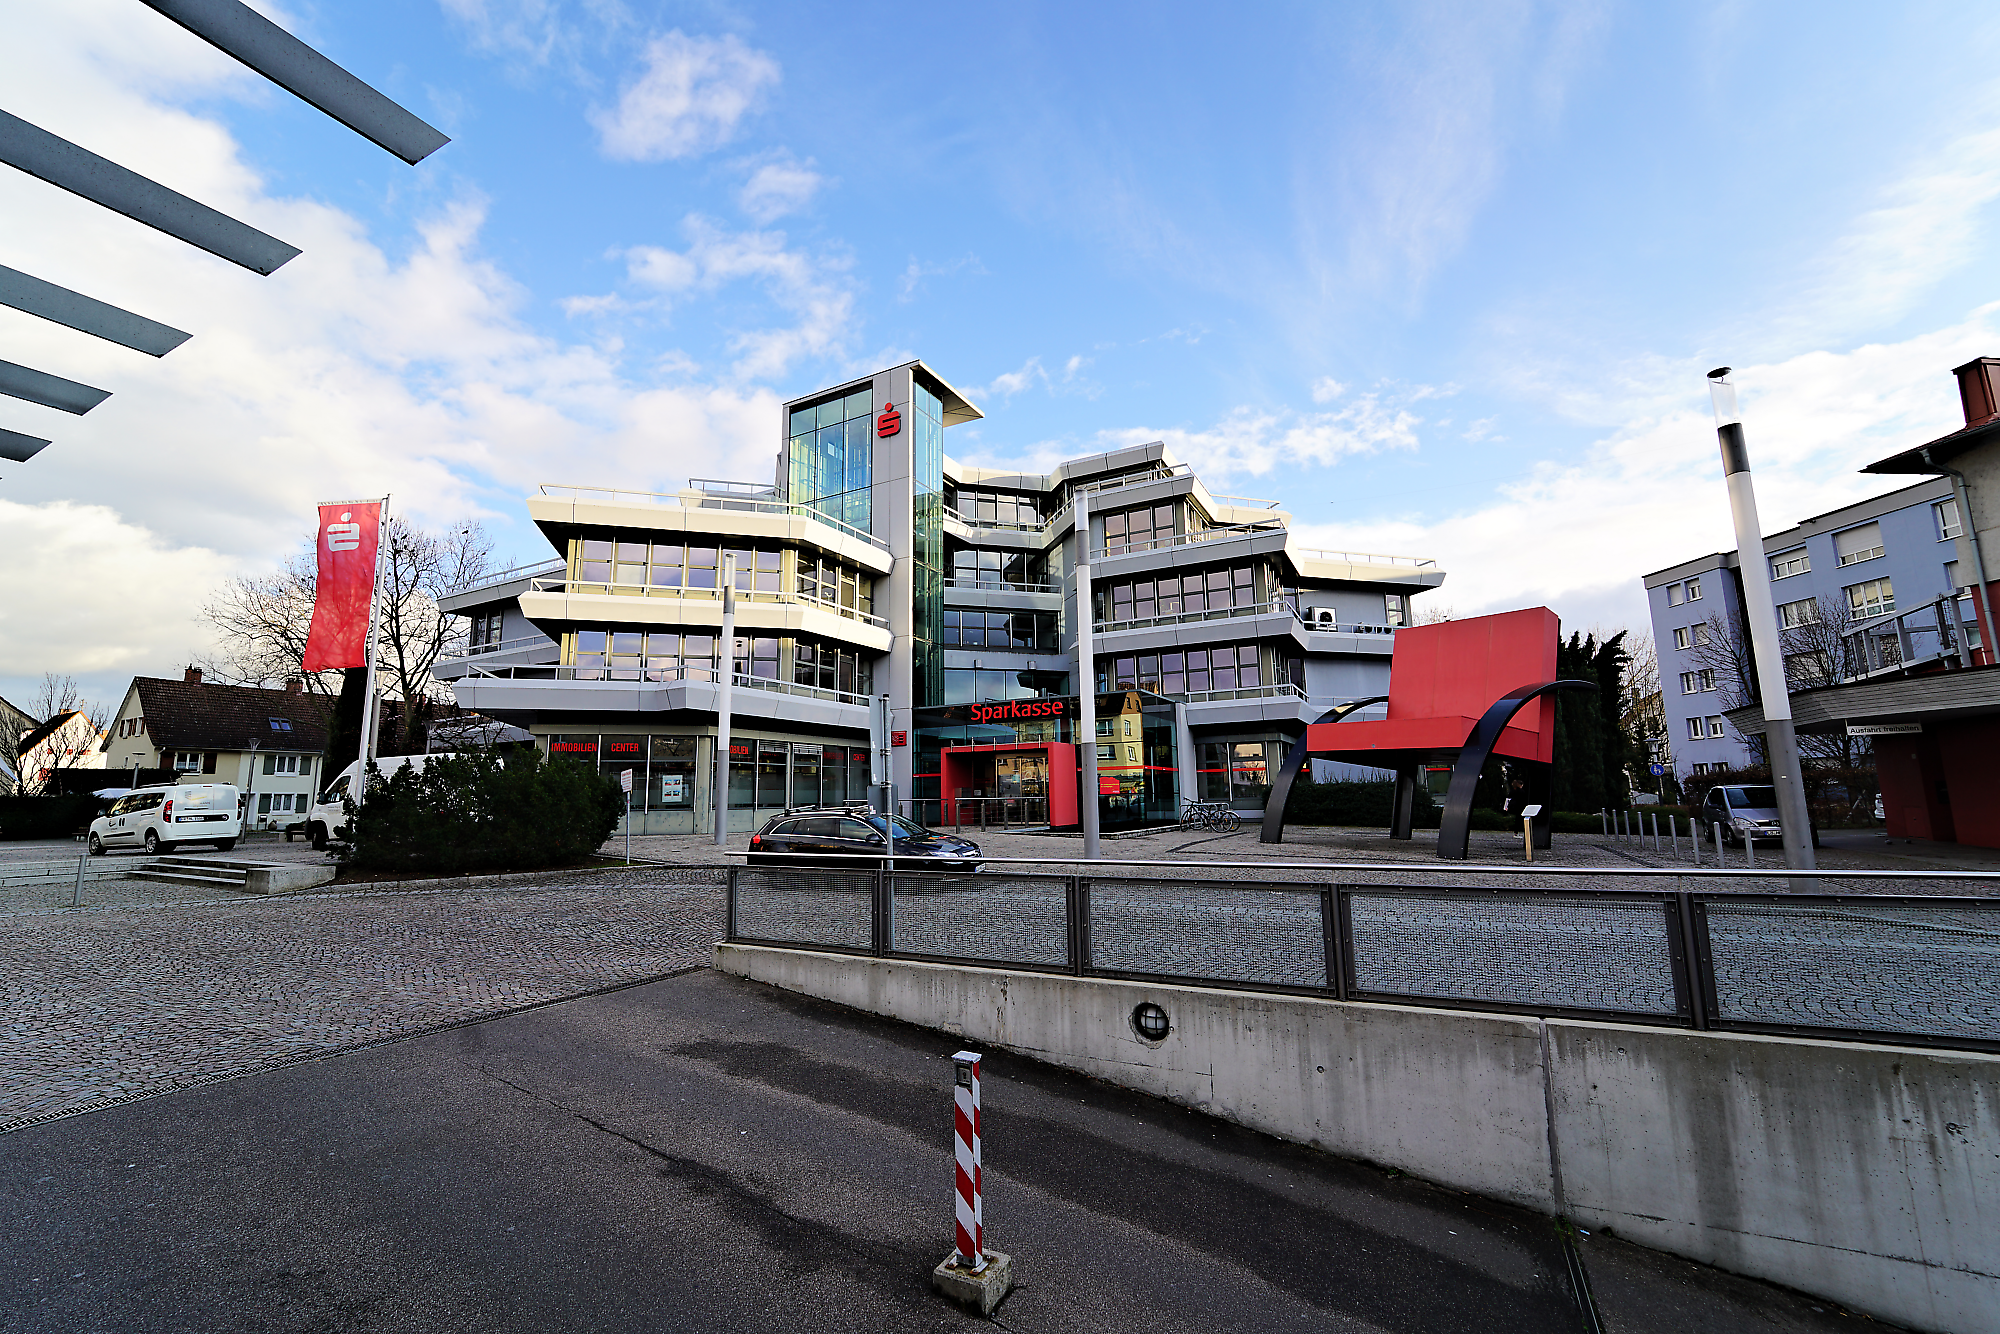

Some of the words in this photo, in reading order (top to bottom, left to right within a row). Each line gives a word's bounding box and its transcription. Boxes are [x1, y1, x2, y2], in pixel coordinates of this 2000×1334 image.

[971, 700, 1063, 724] Sparkasse
[1850, 726, 1881, 734] Ausfahrt
[1883, 725, 1919, 733] freihalten
[551, 742, 597, 752] IMMOBILIEN
[611, 742, 639, 752] CENTER
[729, 745, 749, 755] OBILIEN
